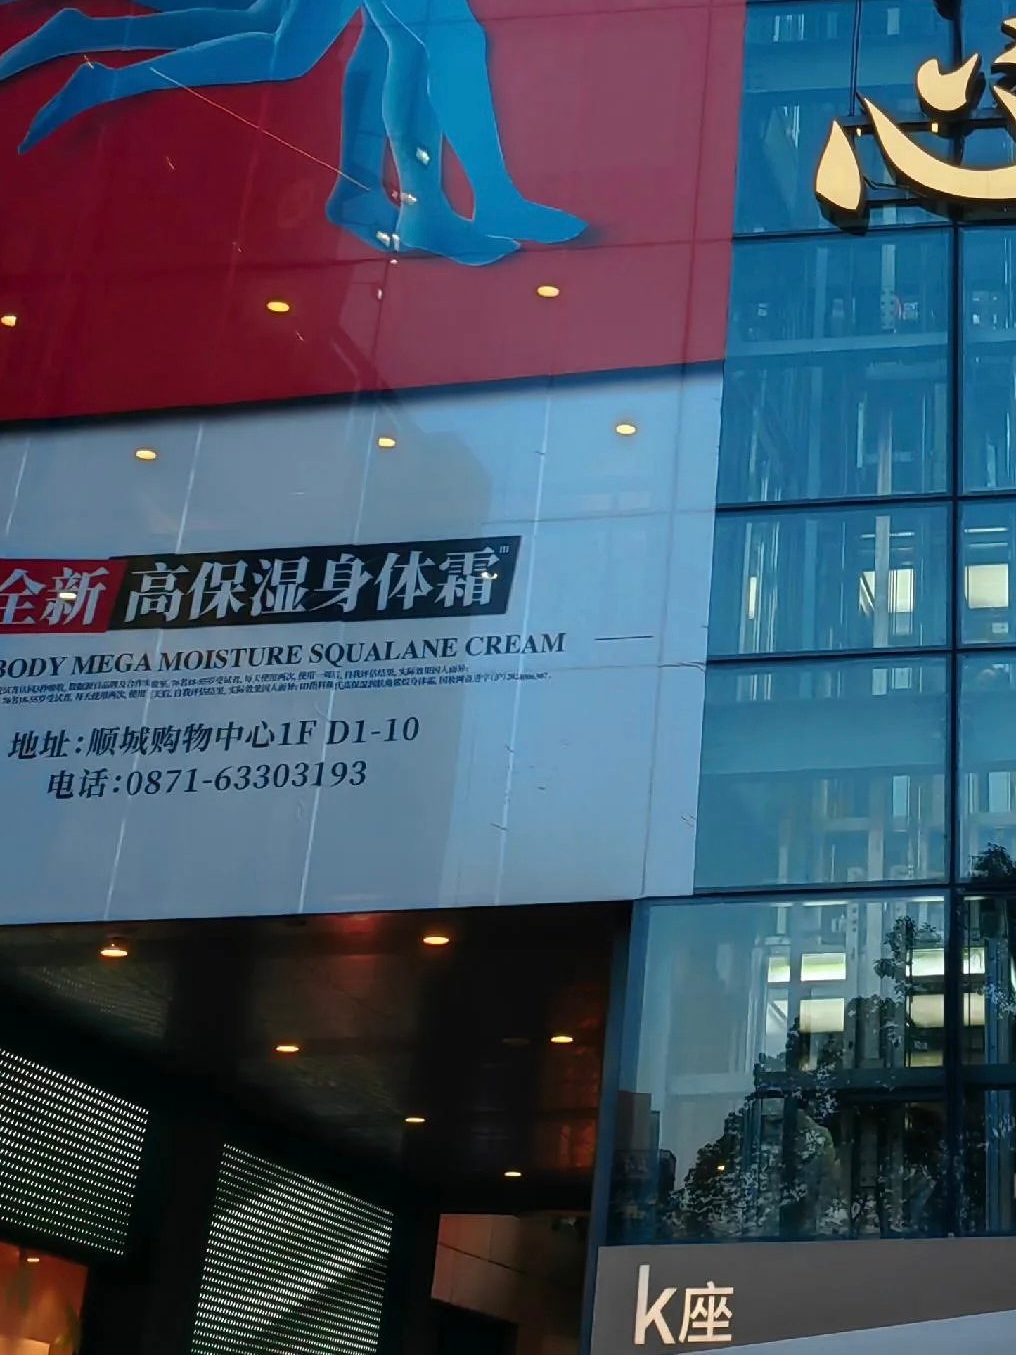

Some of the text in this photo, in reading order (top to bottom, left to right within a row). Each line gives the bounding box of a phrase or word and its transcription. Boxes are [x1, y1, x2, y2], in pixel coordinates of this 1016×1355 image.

[0, 547, 501, 625] 全新 高保湿身体霜
[71, 653, 151, 676] MEGA
[158, 645, 303, 672] MOISTURE
[308, 637, 459, 667] SQUALANE
[464, 632, 567, 656] CREAM
[326, 716, 420, 745] D1-10
[47, 760, 368, 799] 电话:0871-63303193
